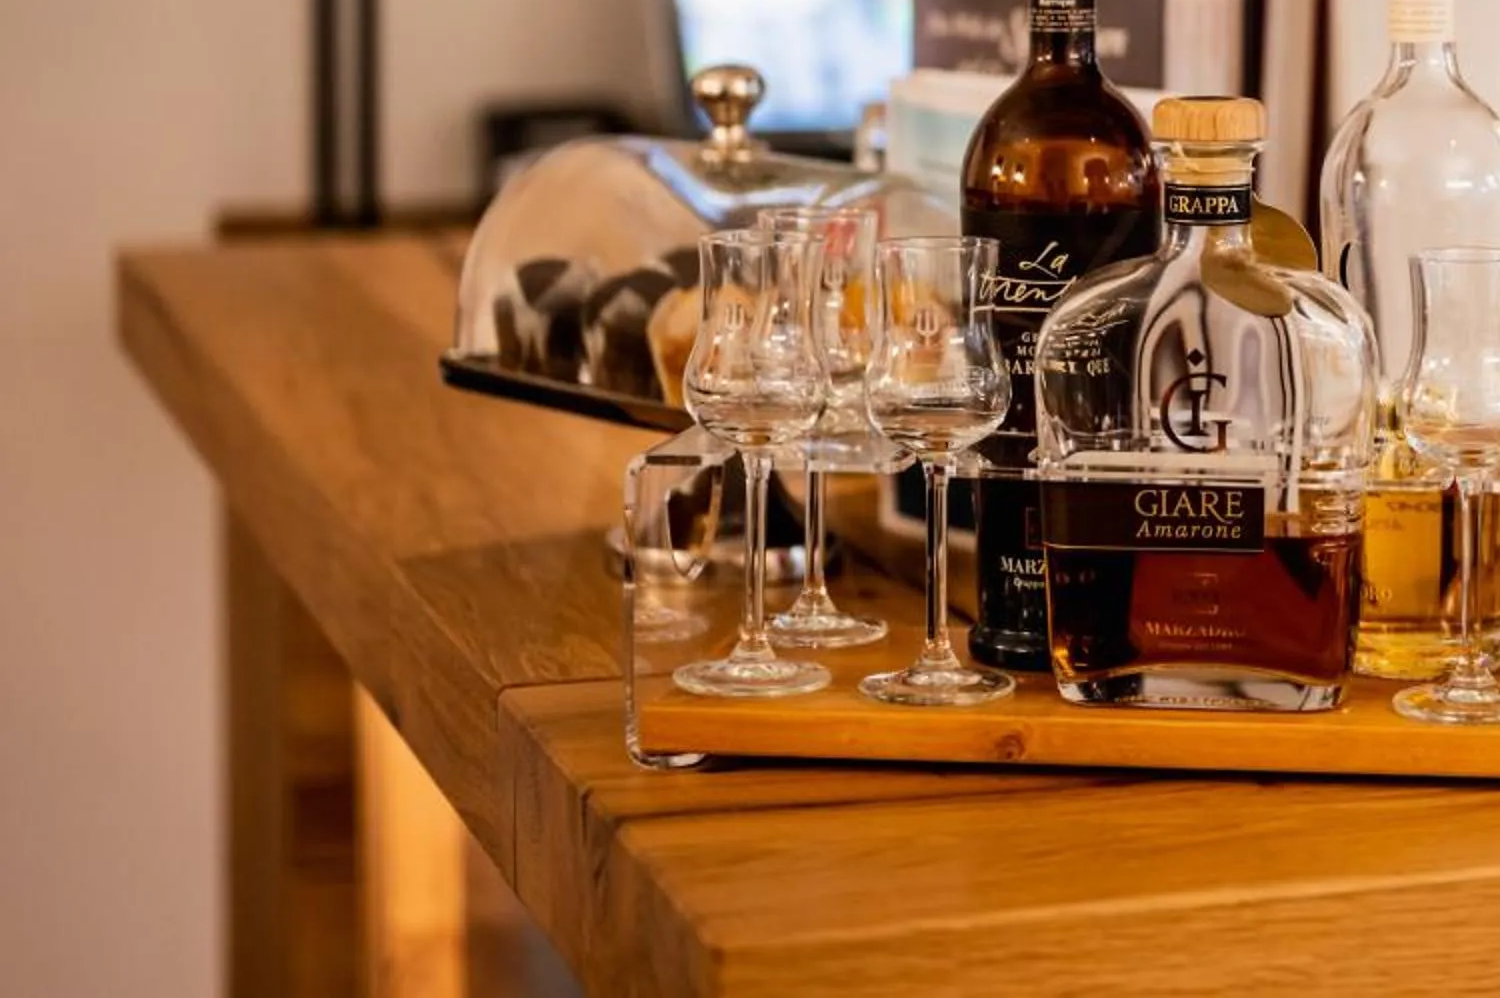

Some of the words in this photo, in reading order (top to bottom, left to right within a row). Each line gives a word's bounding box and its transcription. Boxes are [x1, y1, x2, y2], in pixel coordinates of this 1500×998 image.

[1169, 195, 1240, 214] GRAPPA
[1018, 241, 1069, 279] La
[1134, 489, 1245, 523] GIARE
[1136, 521, 1242, 539] Amarone
